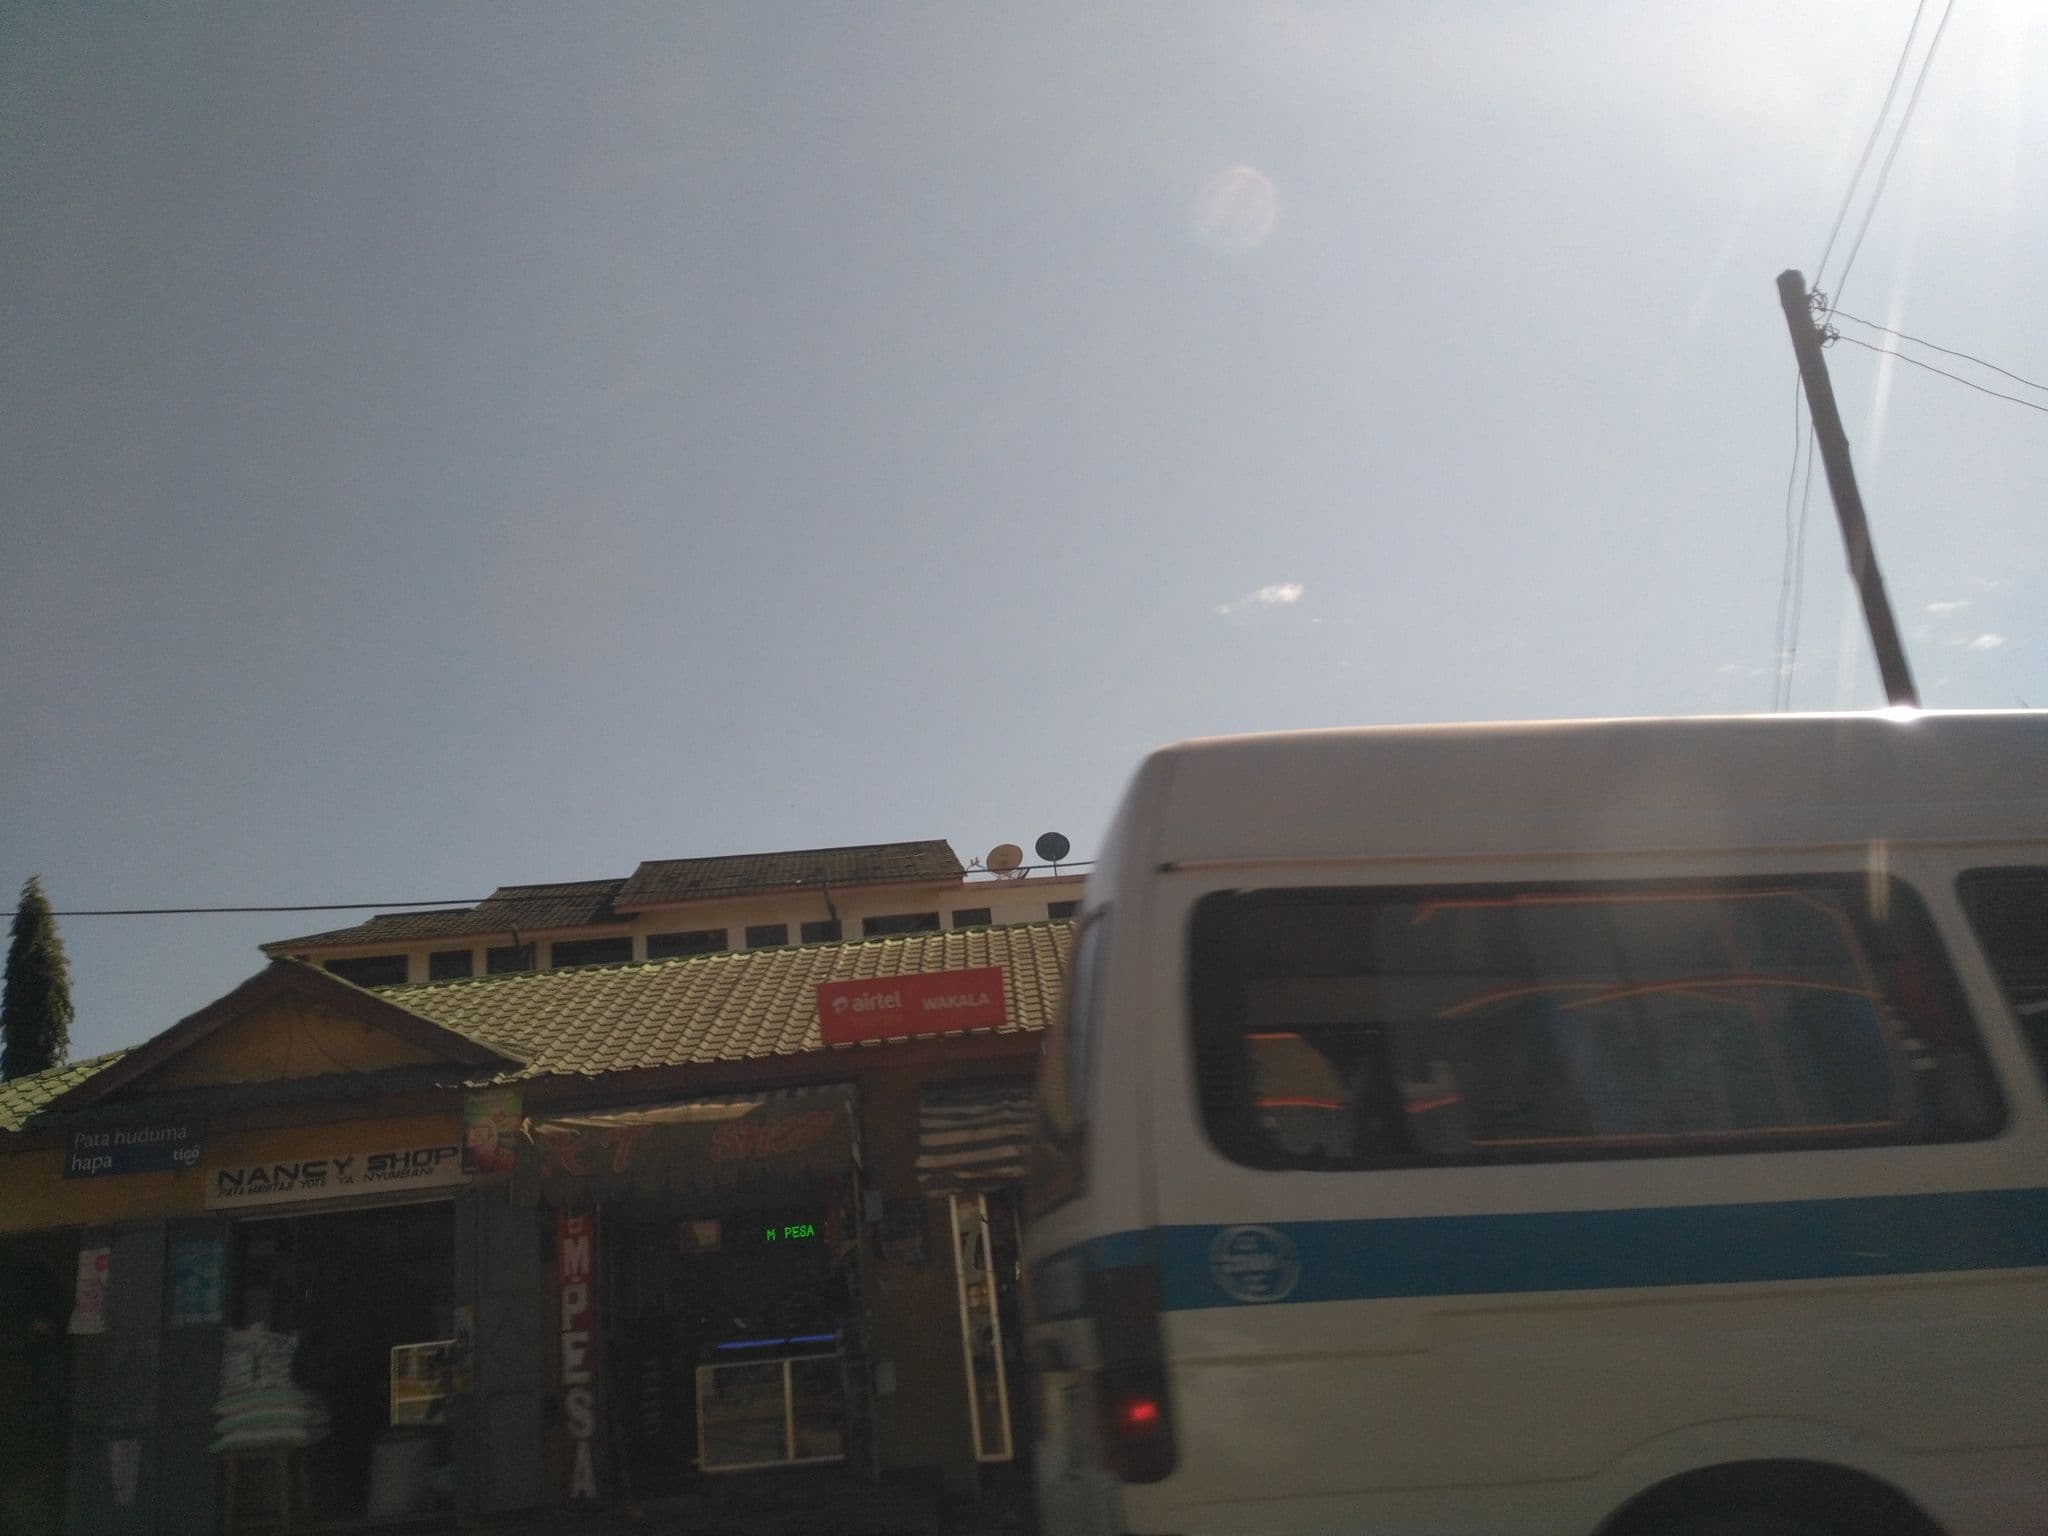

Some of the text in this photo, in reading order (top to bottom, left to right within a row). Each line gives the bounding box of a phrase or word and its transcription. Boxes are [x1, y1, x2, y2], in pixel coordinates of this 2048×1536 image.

[853, 990, 989, 1012] airtel WAKALA
[74, 1127, 187, 1149] Pata huduma
[71, 1154, 113, 1174] hapa
[173, 1145, 200, 1165] tigo
[218, 1147, 458, 1187] NANCY SHOP
[338, 1175, 354, 1186] YA
[766, 1225, 815, 1241] M PESA
